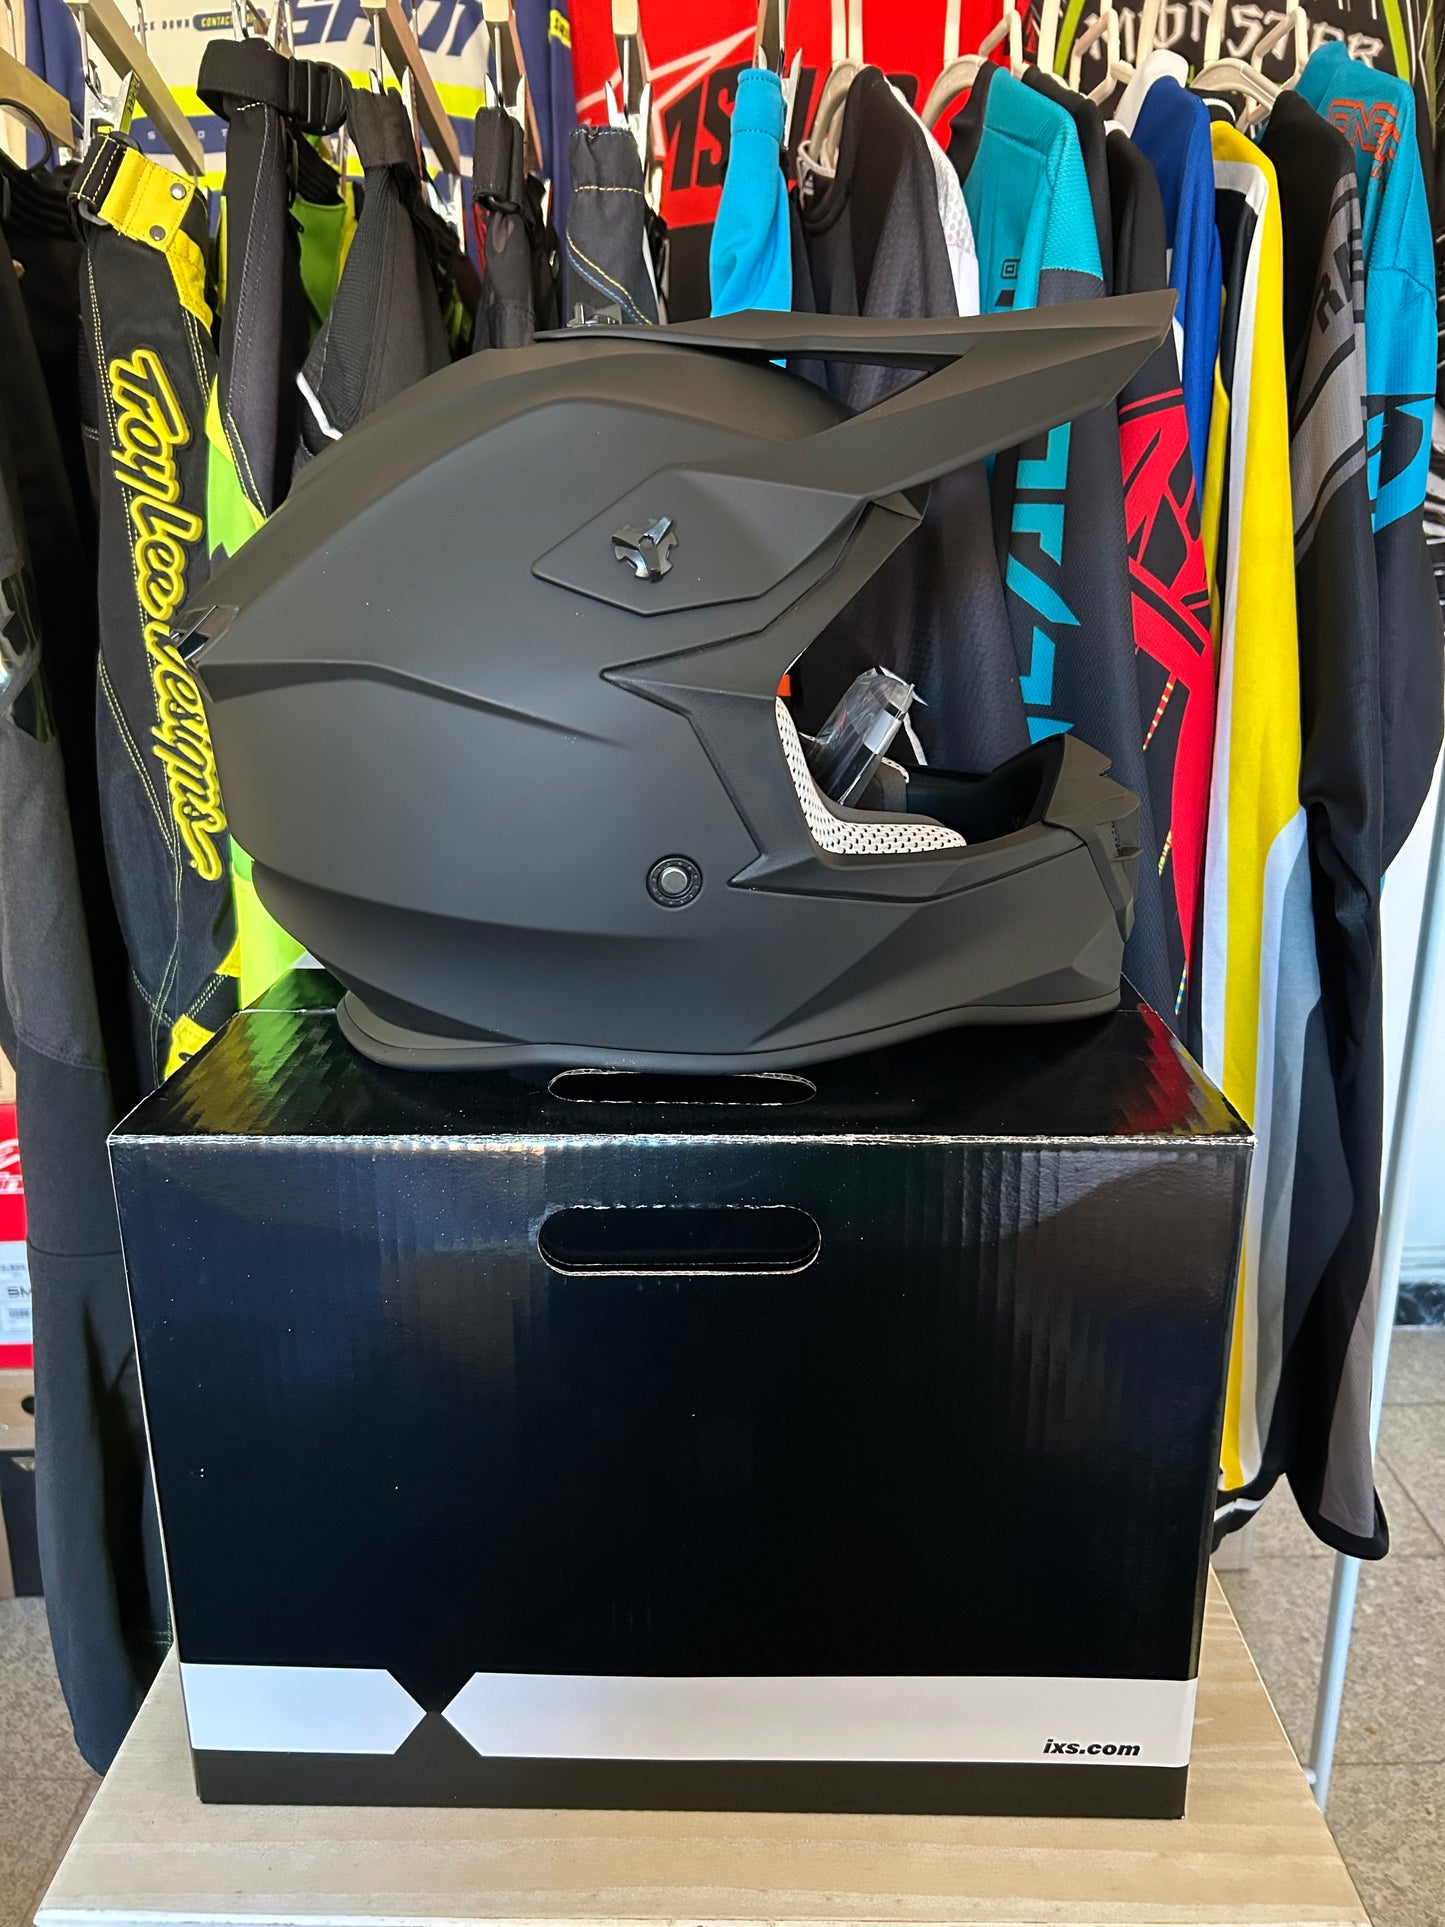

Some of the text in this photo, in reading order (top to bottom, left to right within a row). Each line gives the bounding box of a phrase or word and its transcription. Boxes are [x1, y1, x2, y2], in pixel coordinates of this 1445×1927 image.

[162, 18, 190, 30] DOWN
[109, 348, 190, 500] Troy
[130, 496, 204, 620] Lee
[1043, 1738, 1141, 1757] ixs.com
